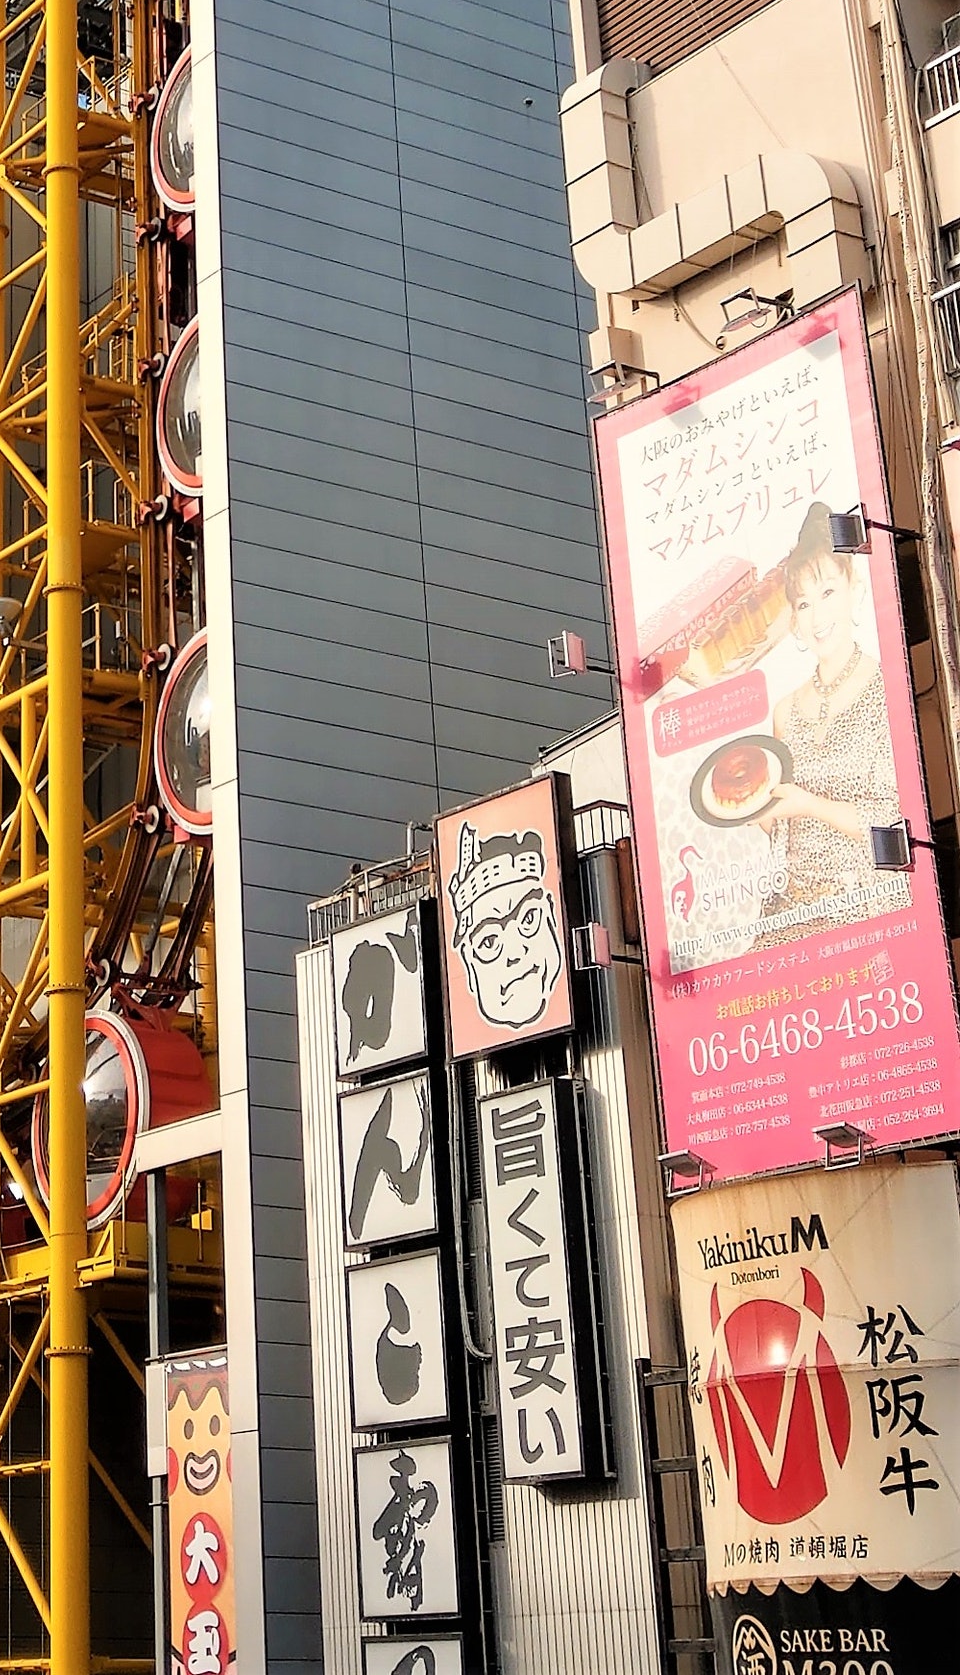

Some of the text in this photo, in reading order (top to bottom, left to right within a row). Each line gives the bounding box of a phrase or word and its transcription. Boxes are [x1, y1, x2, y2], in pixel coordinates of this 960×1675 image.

[643, 399, 818, 496] マダムシンコ
[649, 468, 832, 561] マダムブリュレ
[700, 848, 787, 890] MADAME
[702, 871, 789, 912] SHINCO
[688, 981, 924, 1077] 06-6468-4538
[491, 1097, 567, 1465] 旨くて安い
[731, 1265, 780, 1286] Dotonbori
[857, 1304, 940, 1516] 松阪牛
[780, 1628, 890, 1654] SAKE BAR
